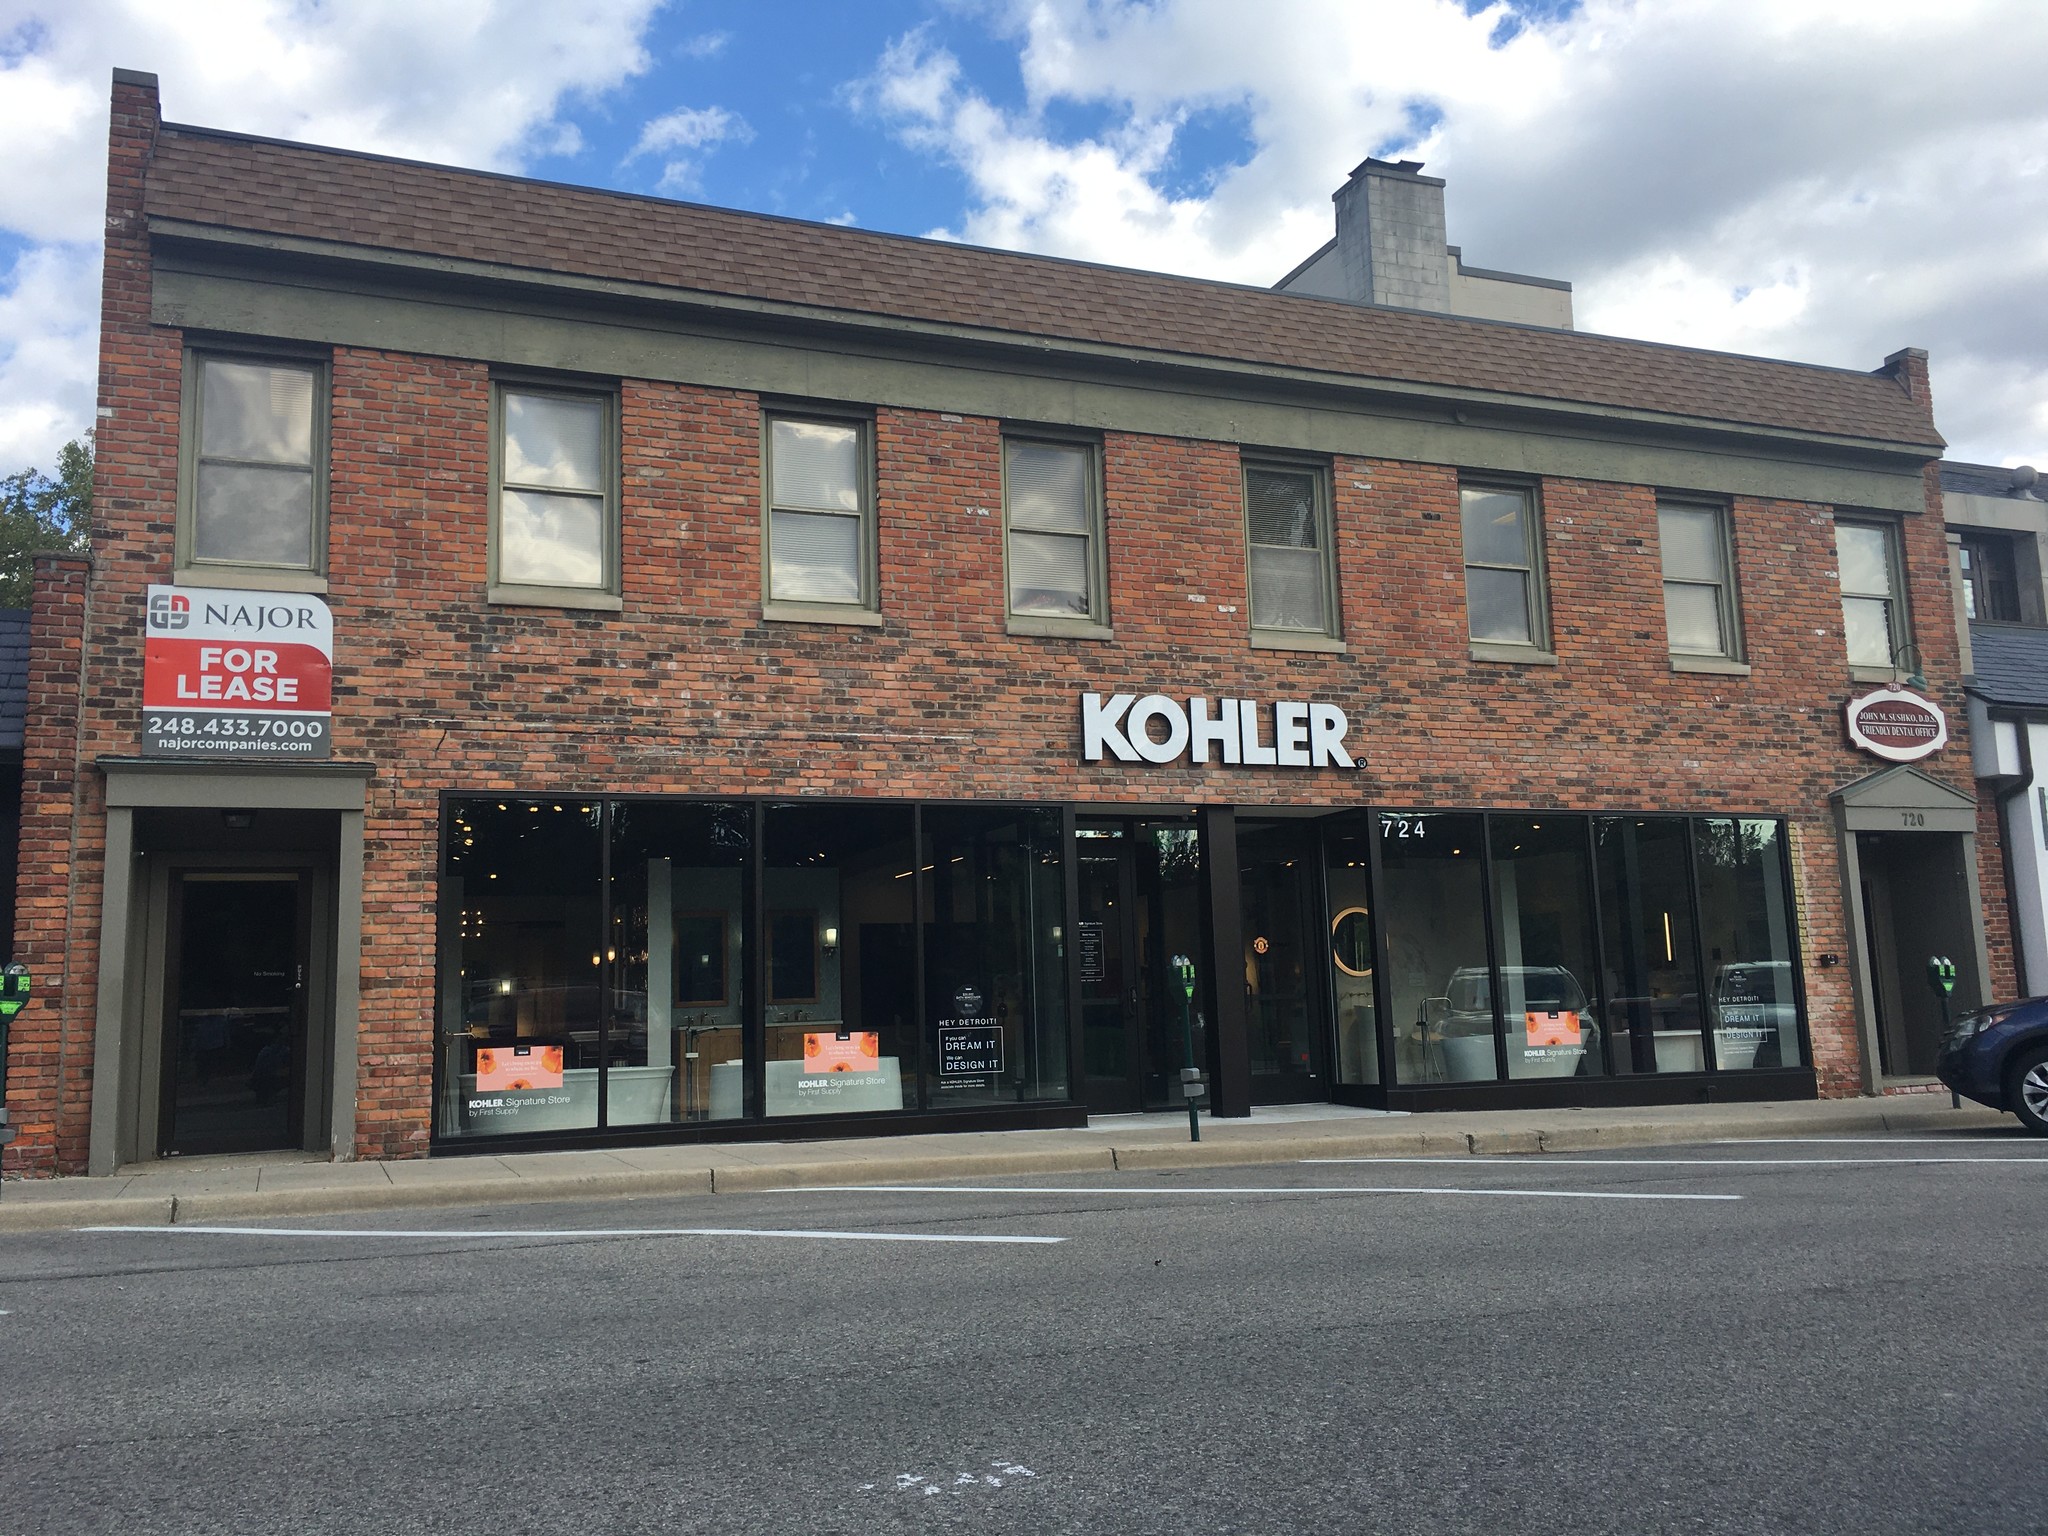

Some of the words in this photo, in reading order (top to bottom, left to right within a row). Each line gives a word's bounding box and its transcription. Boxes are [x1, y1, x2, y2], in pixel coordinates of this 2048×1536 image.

[203, 603, 319, 632] NAJOR
[200, 647, 278, 674] FOR
[177, 674, 298, 702] LEASE
[1889, 683, 1900, 691] 720
[1860, 711, 1878, 720] JOHN
[1880, 712, 1888, 720] M.
[1889, 712, 1918, 723] SUSHKO,
[1919, 714, 1937, 723] D.D.S.
[148, 716, 323, 738] 248.433.7000
[1862, 724, 1891, 735] FRIENDLY
[1891, 726, 1915, 737] DENTAL
[1915, 727, 1937, 738] OFFICE
[158, 737, 312, 751] najorcompanies.com
[1902, 813, 1924, 827] 720
[1381, 820, 1426, 838] 724
[939, 1019, 956, 1027] HEY
[959, 1018, 997, 1026] DETROIT!
[1725, 1015, 1751, 1023] DREAM
[1753, 1014, 1760, 1022] IT
[1726, 1031, 1754, 1039] DESIGN
[1755, 1030, 1763, 1038] IT
[945, 1041, 982, 1051] DREAM
[986, 1040, 996, 1049] IT
[1547, 1048, 1572, 1057] Signature
[1573, 1047, 1588, 1056] Store
[946, 1060, 985, 1070] DESIGN
[989, 1060, 998, 1069] IT
[830, 1078, 865, 1088] Signature
[866, 1076, 886, 1085] Store
[807, 1088, 820, 1096] First
[821, 1087, 842, 1095] Supply
[506, 1096, 546, 1108] Signature
[547, 1095, 571, 1104] Store
[469, 1109, 478, 1117] by
[480, 1108, 494, 1116] First
[495, 1106, 519, 1116] Supply
